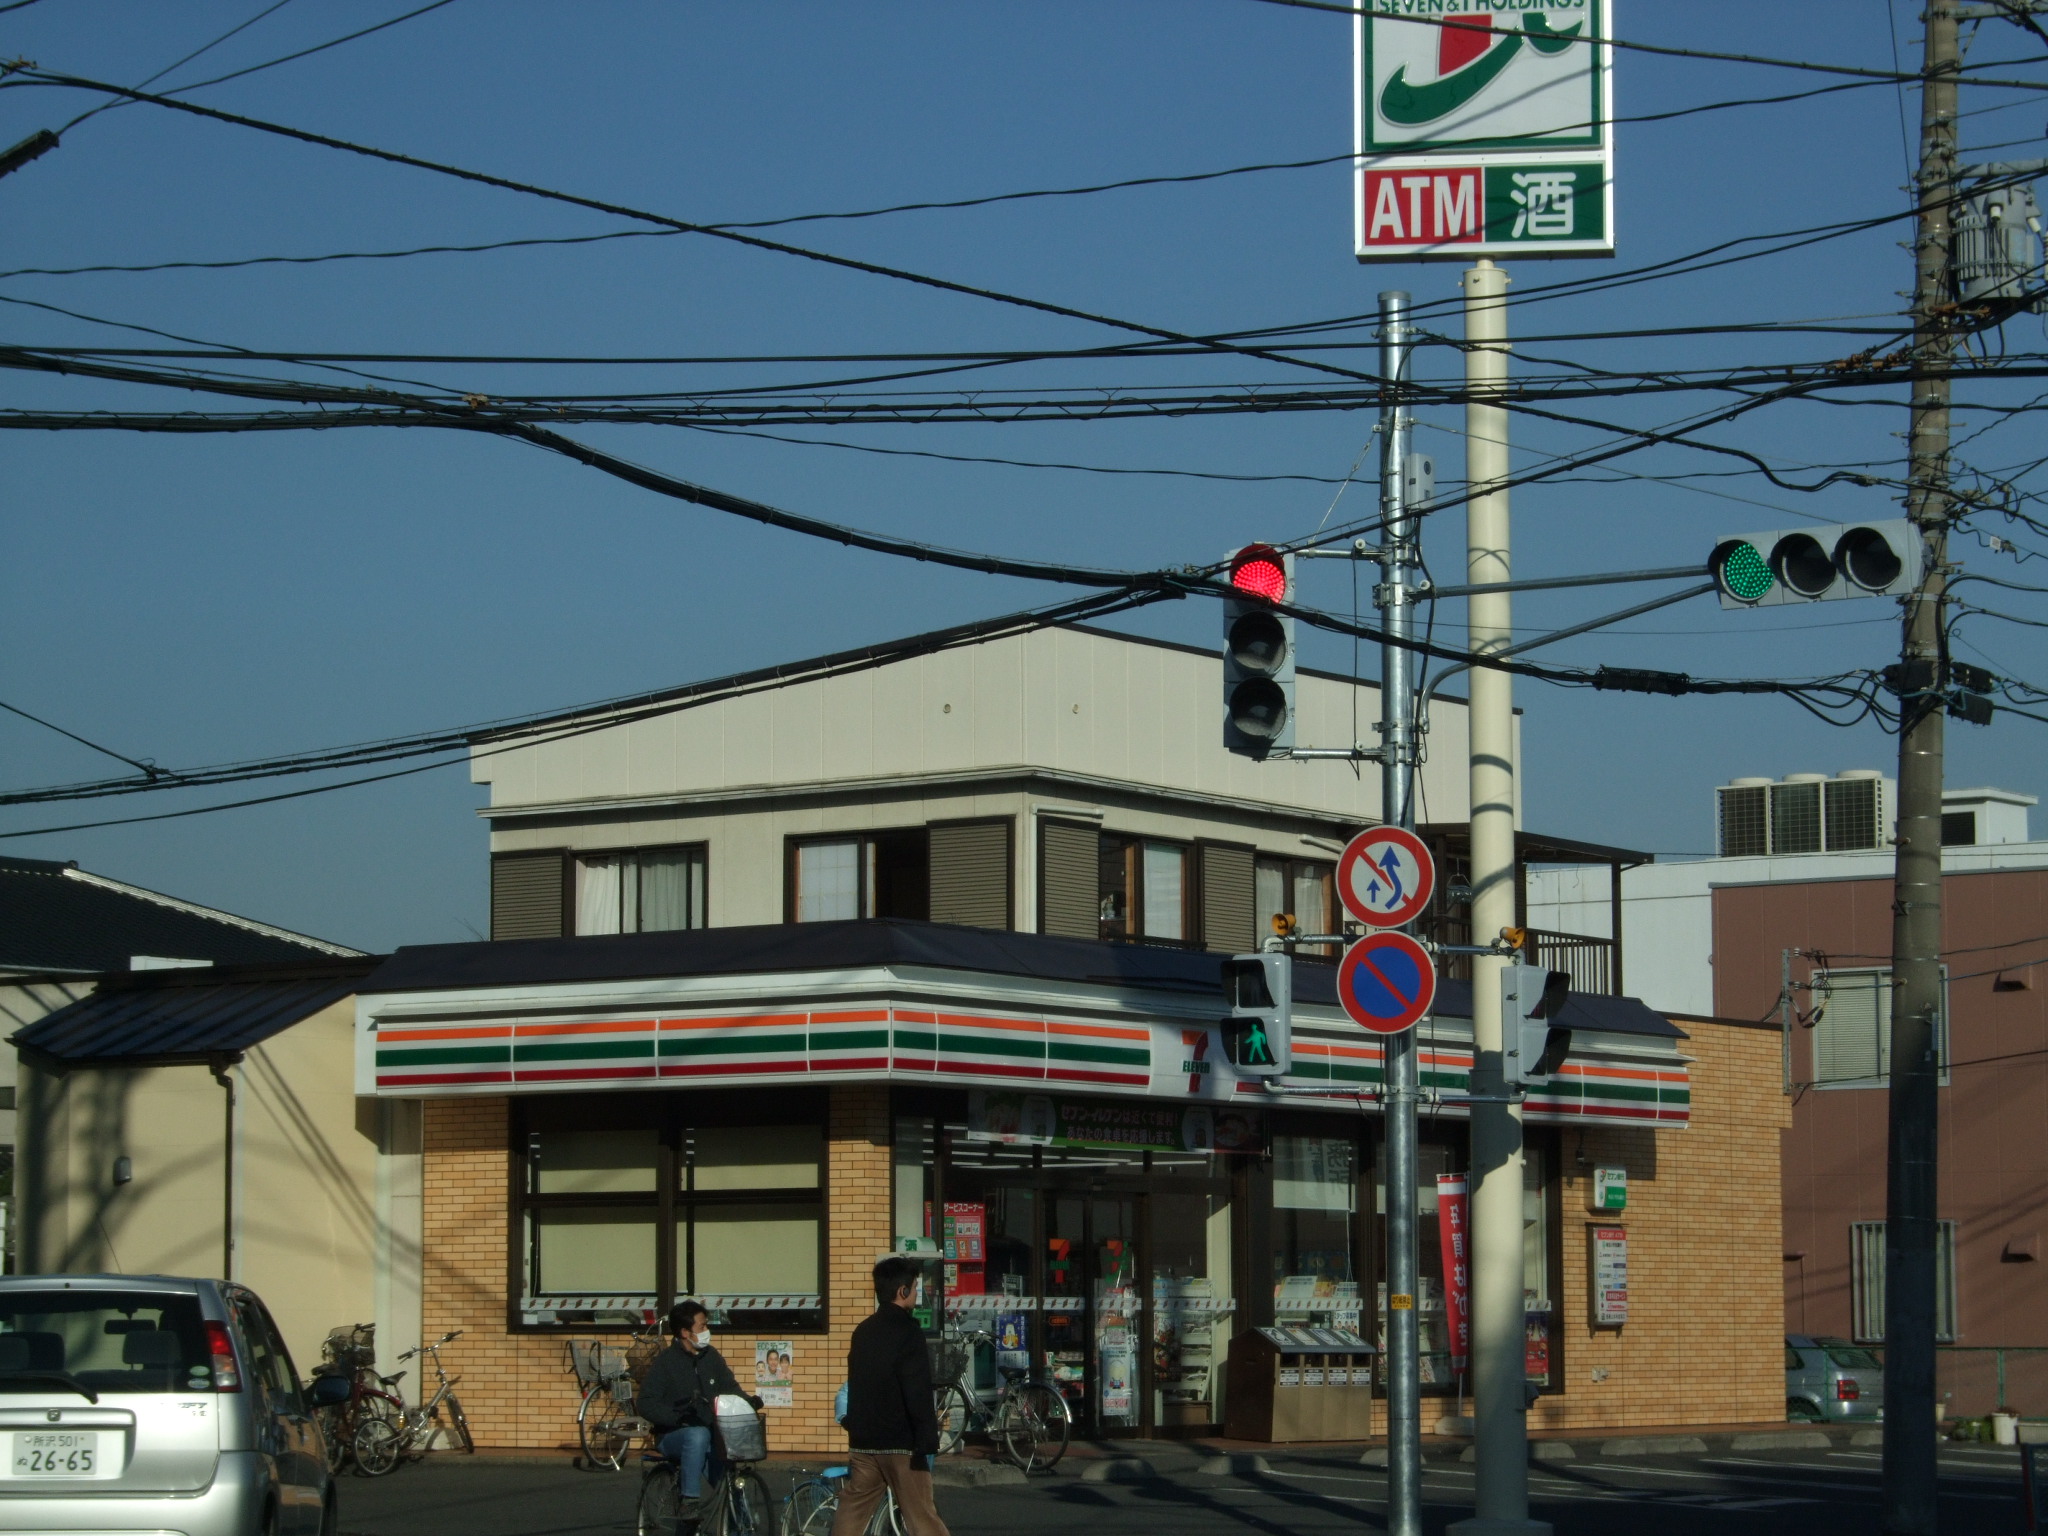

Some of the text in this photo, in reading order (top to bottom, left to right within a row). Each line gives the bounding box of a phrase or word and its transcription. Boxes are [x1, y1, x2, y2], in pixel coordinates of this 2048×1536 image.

[1369, 175, 1475, 239] ATM
[1510, 171, 1576, 238] 酒
[905, 1239, 917, 1252] 酒
[33, 1436, 78, 1447] 所沢 501
[31, 1450, 93, 1471] 26-65
